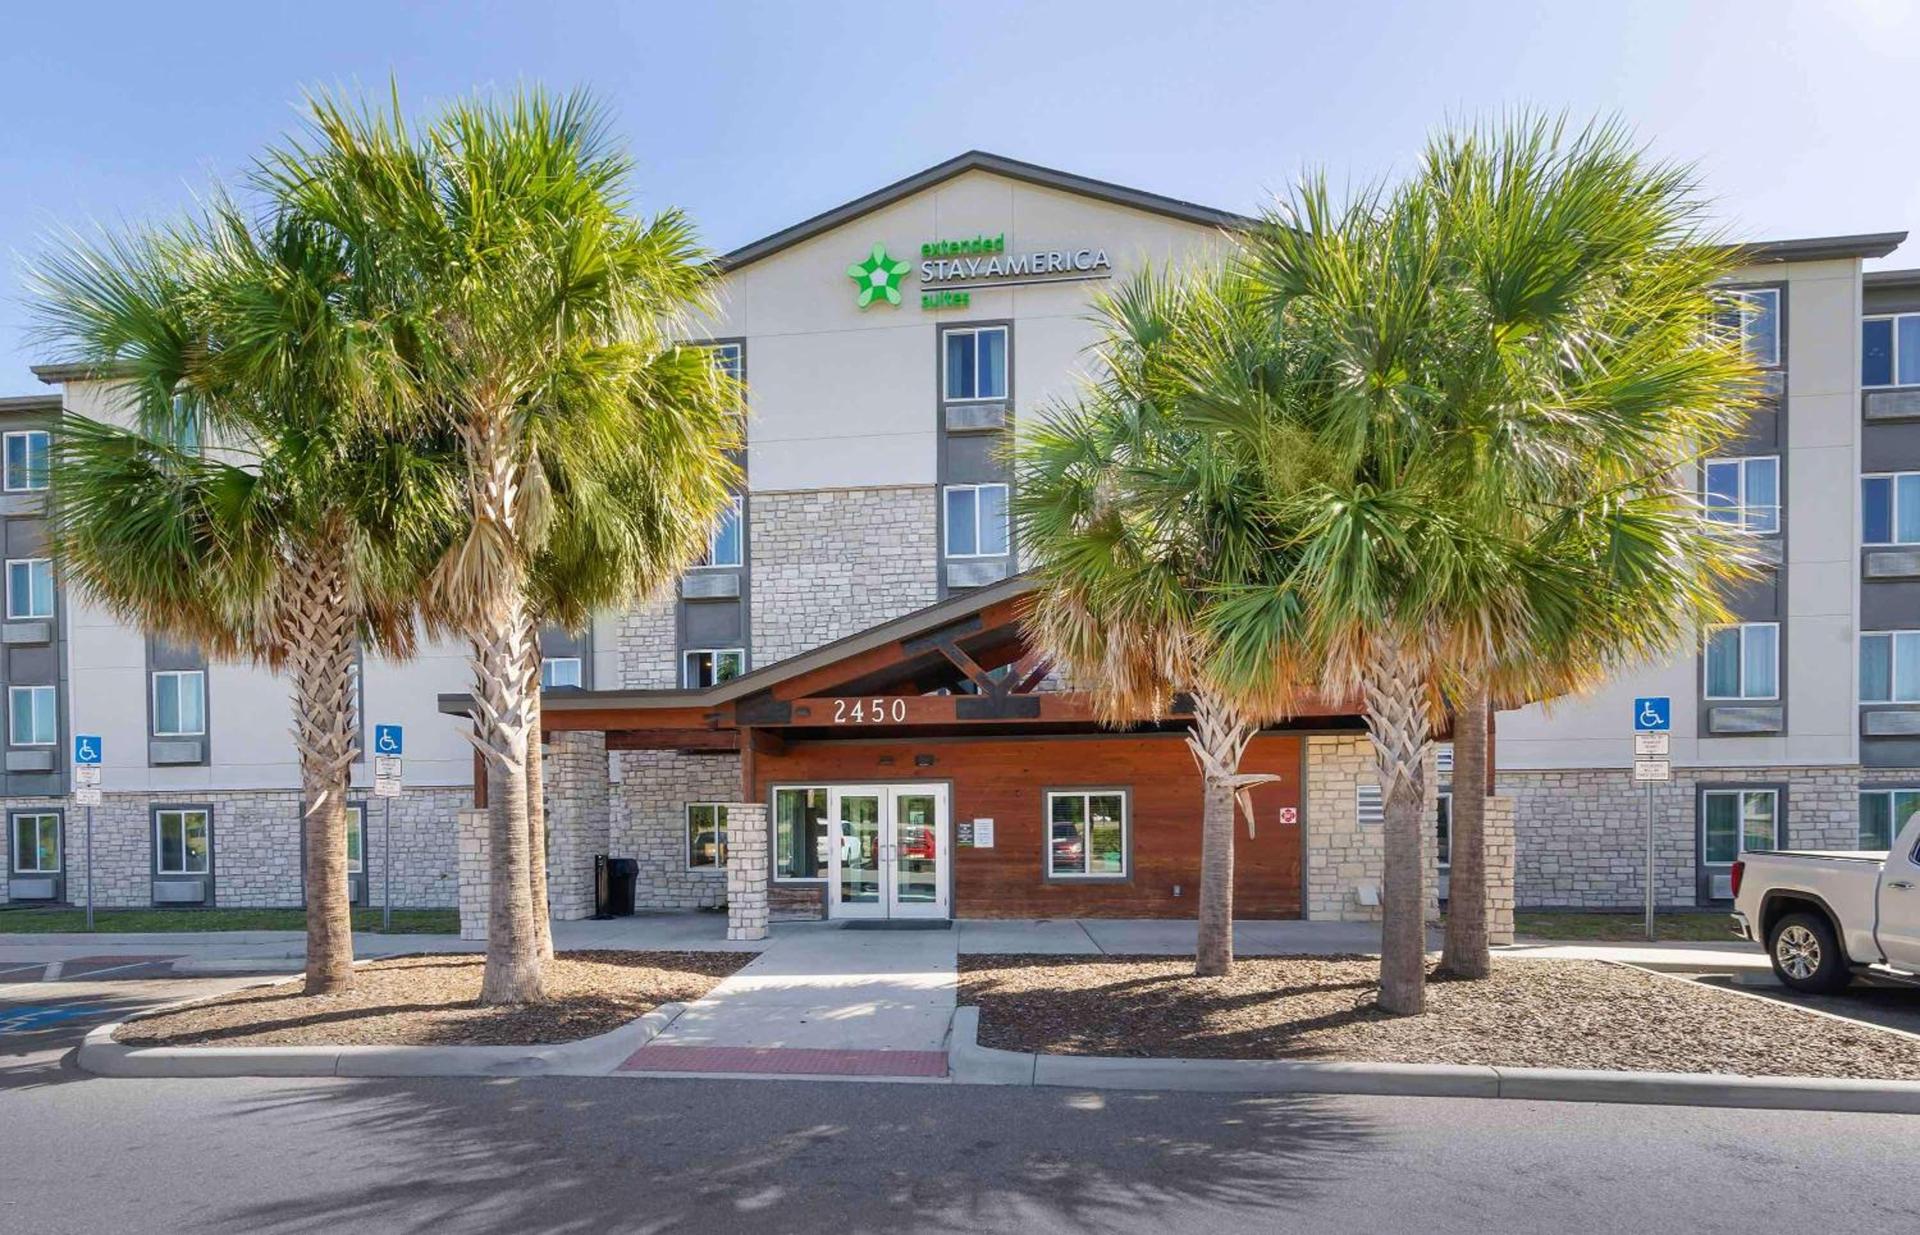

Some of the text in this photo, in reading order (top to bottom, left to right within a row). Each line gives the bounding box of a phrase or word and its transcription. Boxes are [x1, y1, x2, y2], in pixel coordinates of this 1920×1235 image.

[921, 233, 1004, 257] extended
[921, 291, 970, 309] suites
[834, 698, 906, 723] 2450
